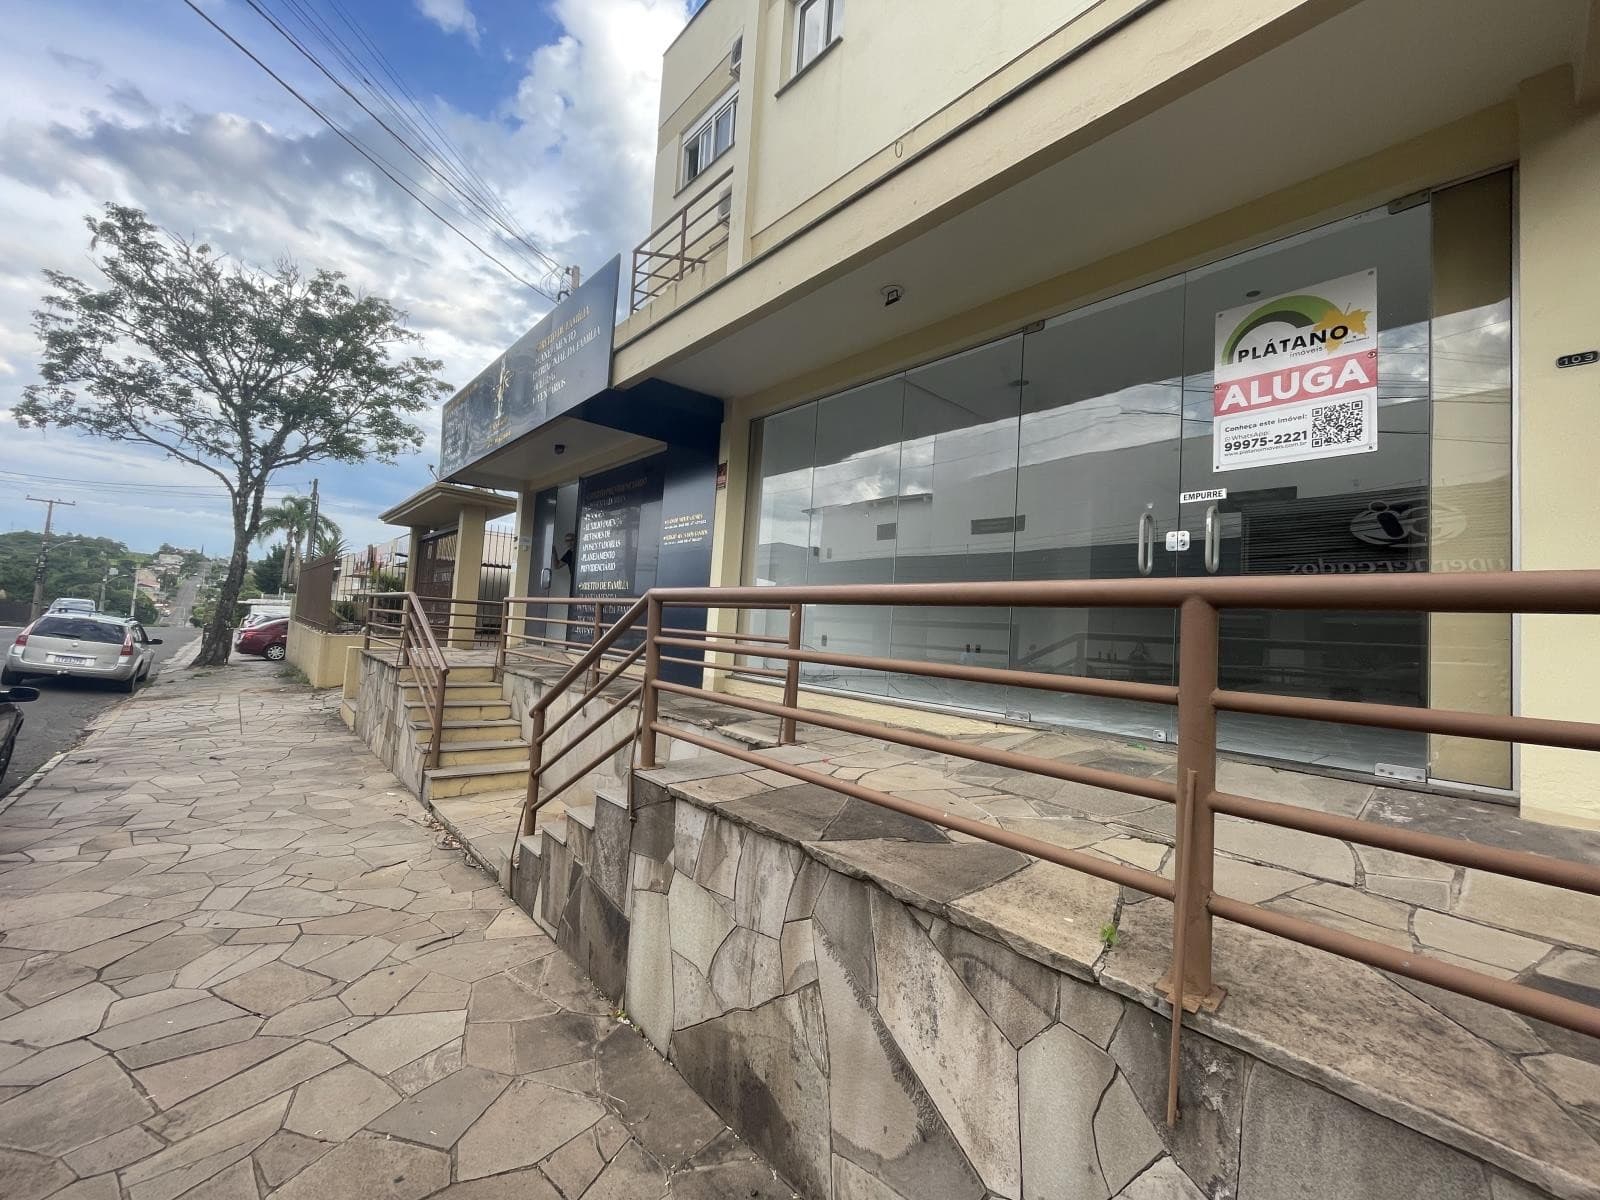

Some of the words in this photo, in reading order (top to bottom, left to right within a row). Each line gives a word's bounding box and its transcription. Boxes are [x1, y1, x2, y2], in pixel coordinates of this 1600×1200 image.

[1238, 325, 1349, 363] PLÁTANO
[1289, 346, 1323, 359] imóveis
[1559, 352, 1594, 366] 103
[1219, 358, 1370, 411] ALUGA
[1224, 422, 1257, 433] Conheça
[1259, 419, 1276, 427] este
[1277, 413, 1308, 424] imóvel:
[1224, 430, 1307, 452] 99975-2221
[1183, 489, 1224, 501] EMPURRE
